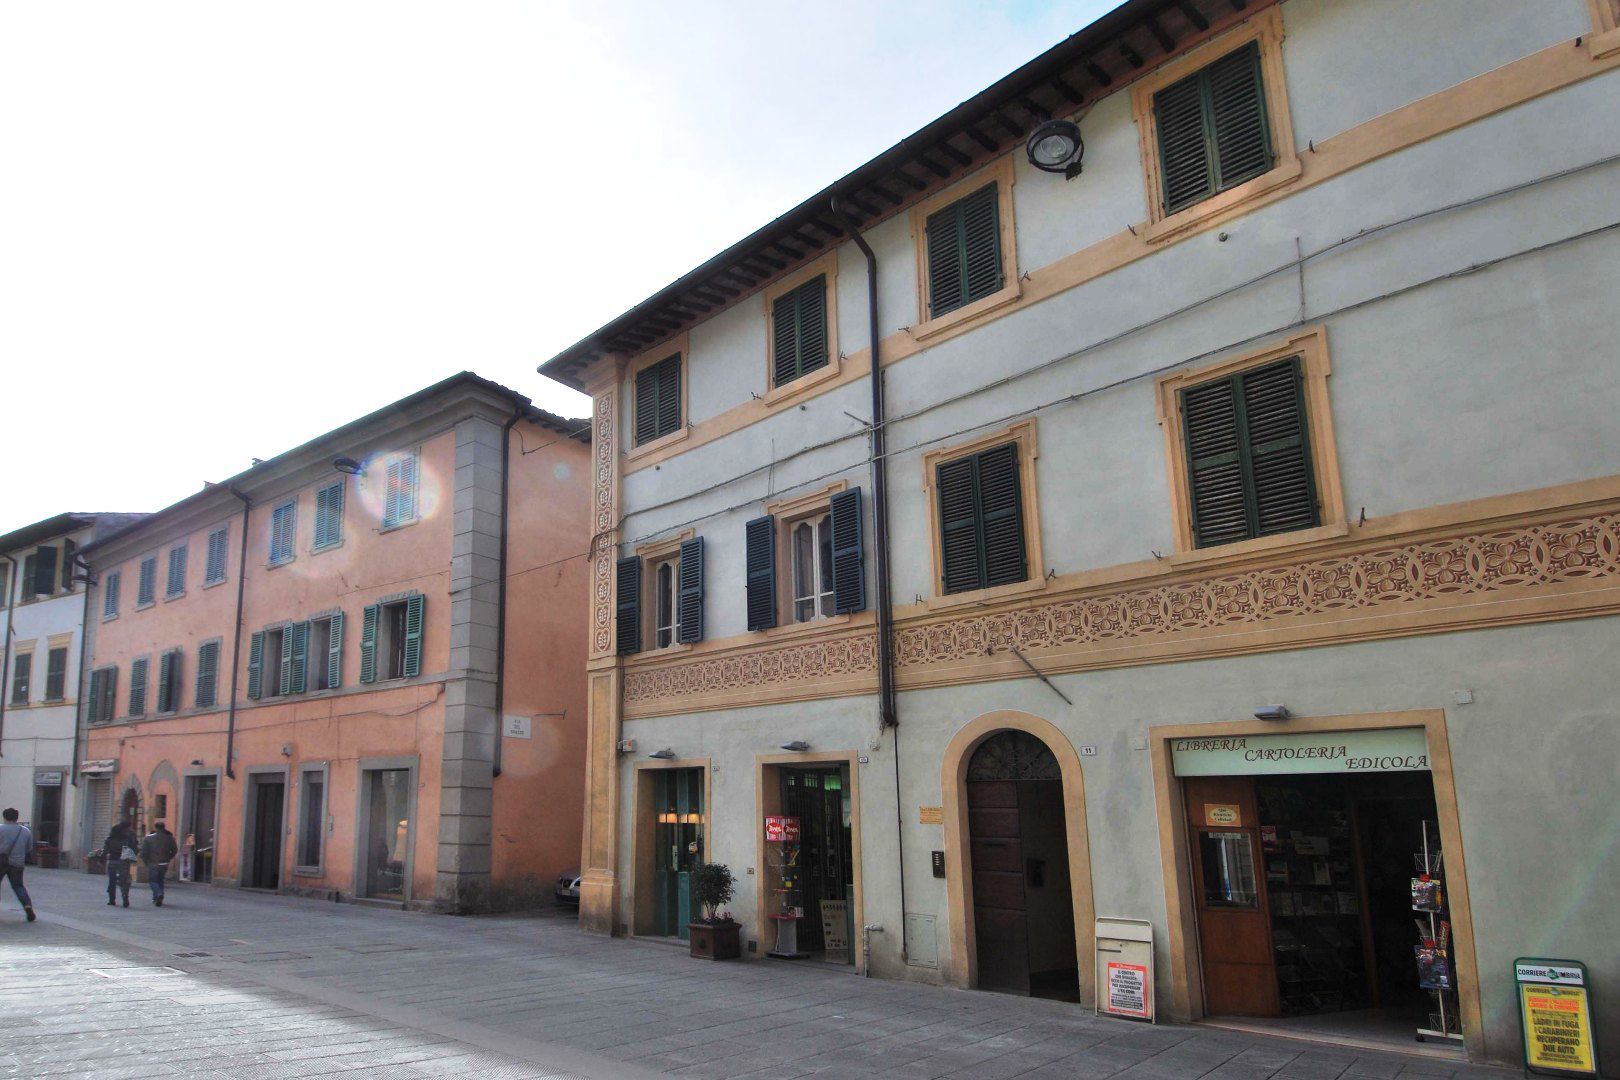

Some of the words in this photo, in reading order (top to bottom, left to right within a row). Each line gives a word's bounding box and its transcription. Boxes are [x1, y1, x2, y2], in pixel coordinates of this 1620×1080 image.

[1176, 739, 1247, 752] LIBRERIA
[1244, 746, 1347, 762] CARTOLERIA
[1346, 756, 1429, 770] EDICOLA
[1518, 968, 1546, 977] CORRIERE
[1561, 1020, 1579, 1029] FUGA
[1538, 1027, 1580, 1037] CARABINIERI
[1537, 1035, 1580, 1046] RECUPERANO
[1543, 1044, 1556, 1052] DUE
[1558, 1046, 1575, 1054] AUTO
